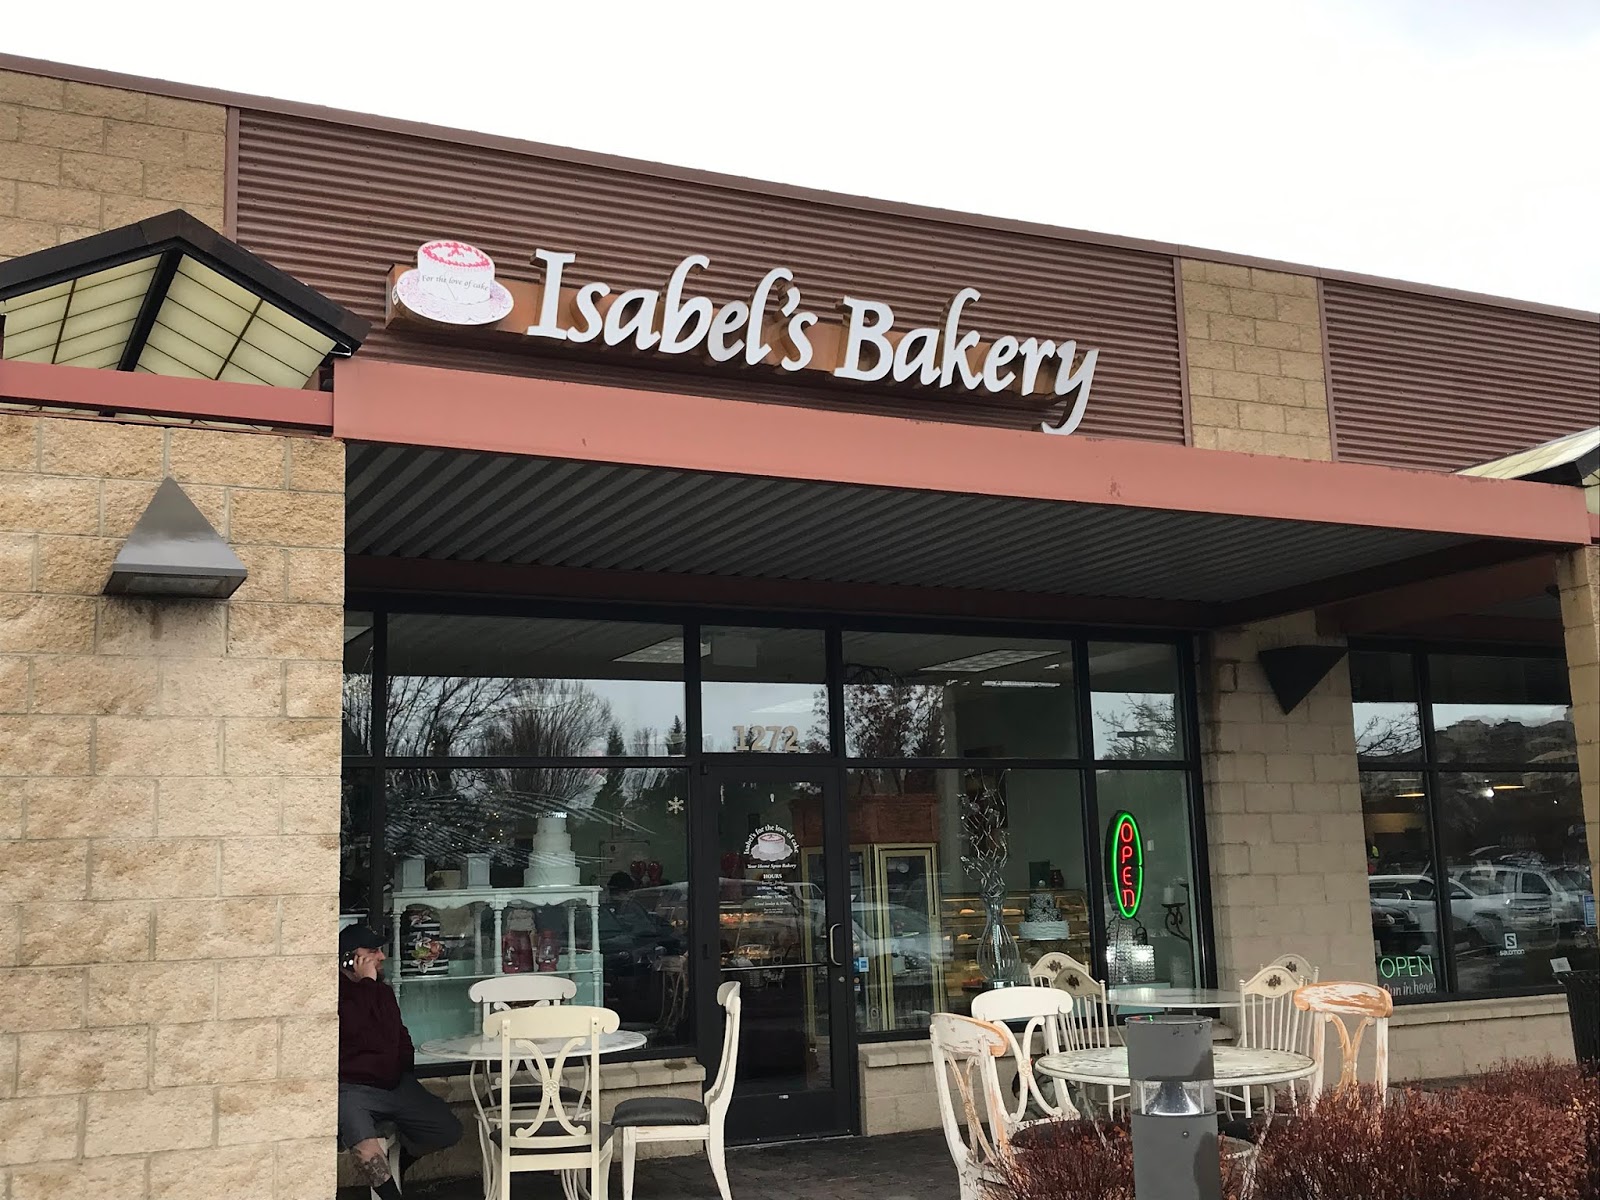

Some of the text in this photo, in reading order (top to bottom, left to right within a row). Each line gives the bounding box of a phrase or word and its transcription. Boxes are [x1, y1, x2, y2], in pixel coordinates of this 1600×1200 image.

[422, 274, 489, 291] For the love of cake
[526, 248, 1100, 436] Isabel's Bakery
[732, 725, 799, 752] 1272
[755, 827, 764, 835] for
[775, 824, 787, 835] love
[786, 831, 795, 839] of
[790, 838, 800, 854] cake
[1120, 822, 1135, 907] OPEN
[1379, 955, 1434, 979] OPEN
[1403, 981, 1413, 995] in
